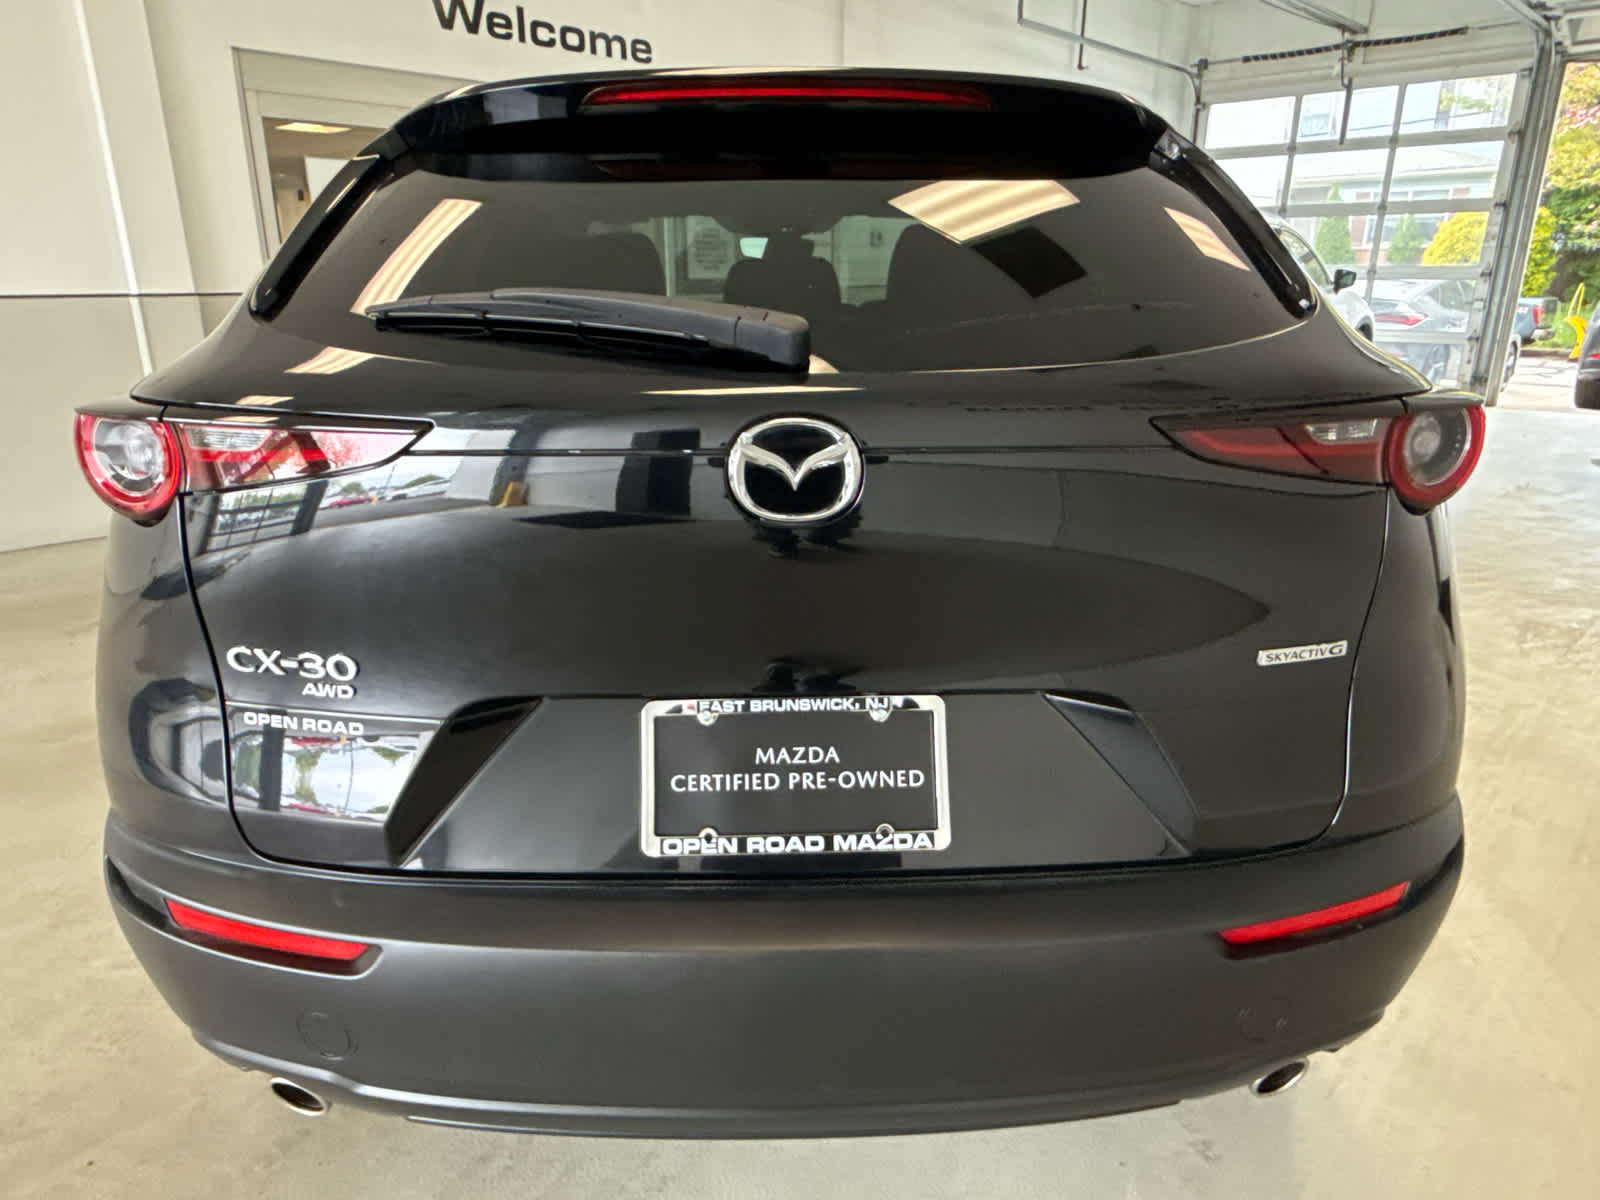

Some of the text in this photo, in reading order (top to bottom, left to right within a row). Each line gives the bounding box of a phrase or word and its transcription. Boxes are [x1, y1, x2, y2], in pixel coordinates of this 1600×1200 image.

[432, 0, 652, 64] Welcome
[226, 646, 357, 681] CX-30
[302, 683, 354, 699] AWD
[750, 698, 860, 713] BRUNSWICK,
[865, 697, 889, 710] NJ
[243, 712, 364, 735] OPEN ROAD
[755, 747, 840, 764] MAZDA
[670, 770, 925, 792] CERTIFIED PRE-OWNED
[662, 832, 934, 855] OPEN ROAD MAZDA
